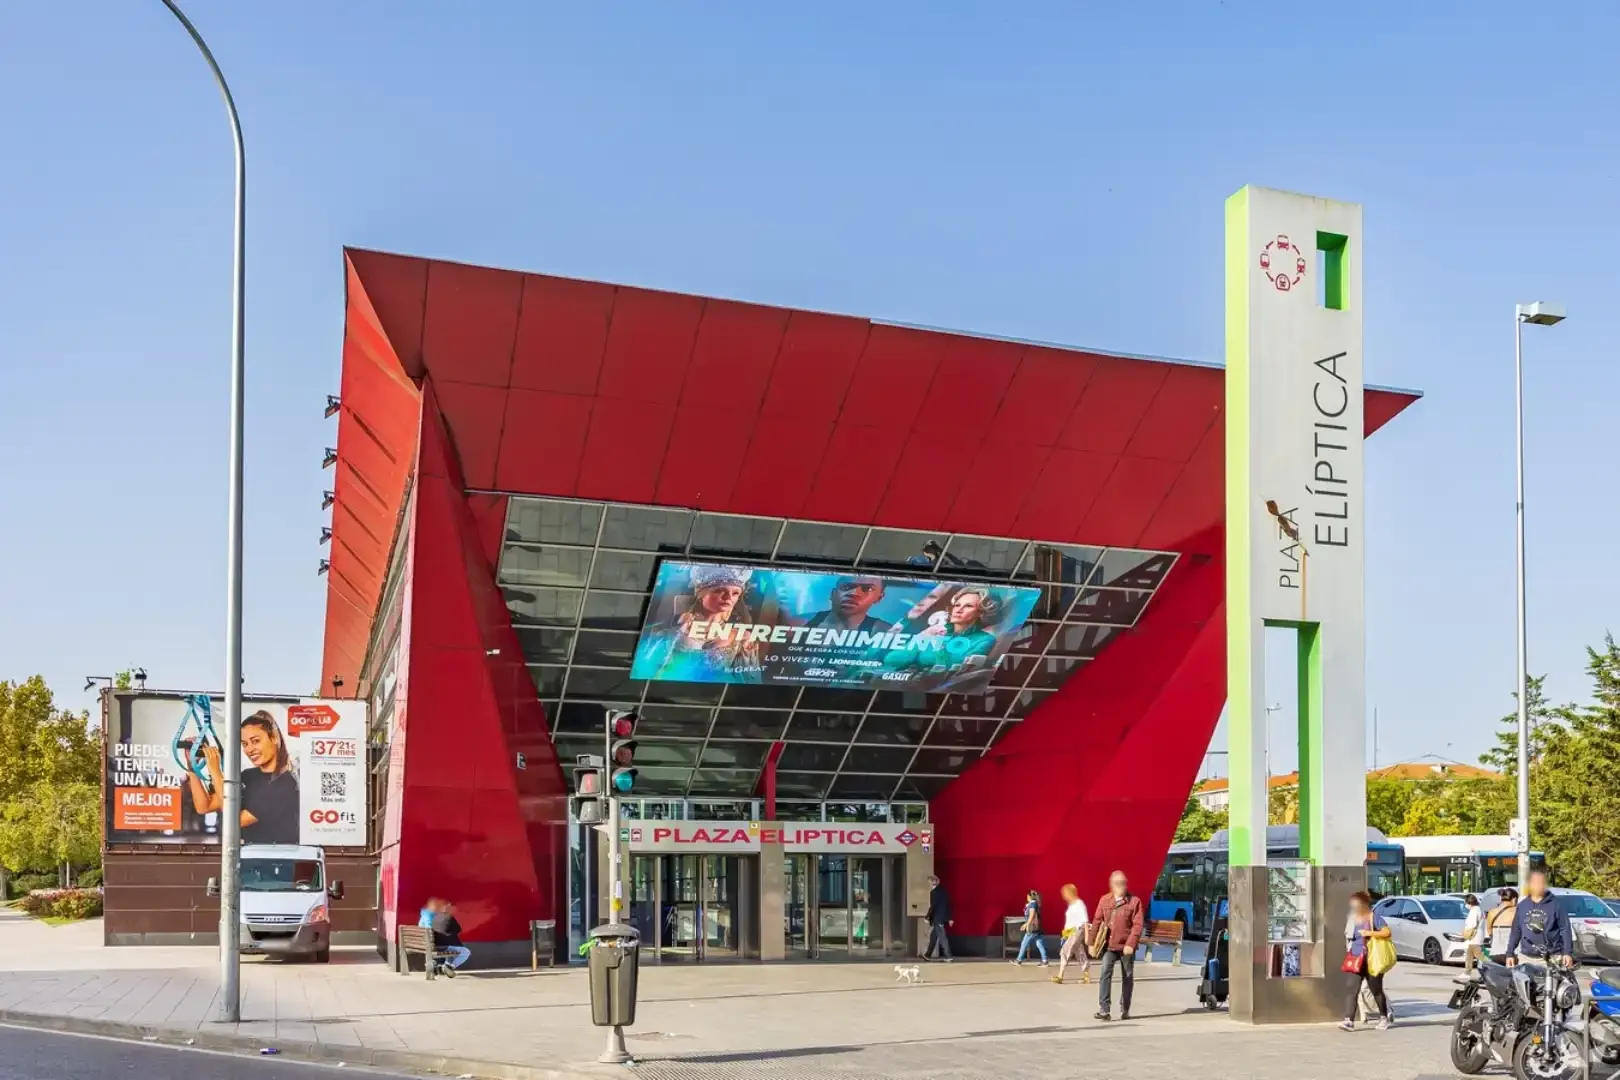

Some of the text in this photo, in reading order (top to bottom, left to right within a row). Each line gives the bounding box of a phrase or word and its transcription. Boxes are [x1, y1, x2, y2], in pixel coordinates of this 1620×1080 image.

[1305, 351, 1348, 547] ELÍPTICA
[688, 621, 970, 652] ENTRETENIMIENTO
[812, 657, 826, 665] EN
[114, 743, 169, 757] PUEDES
[115, 758, 160, 771] TENER
[114, 772, 181, 786] UNA VIDA
[122, 792, 172, 806] MEJOR
[653, 828, 885, 845] PLAZA ELIPTICA
